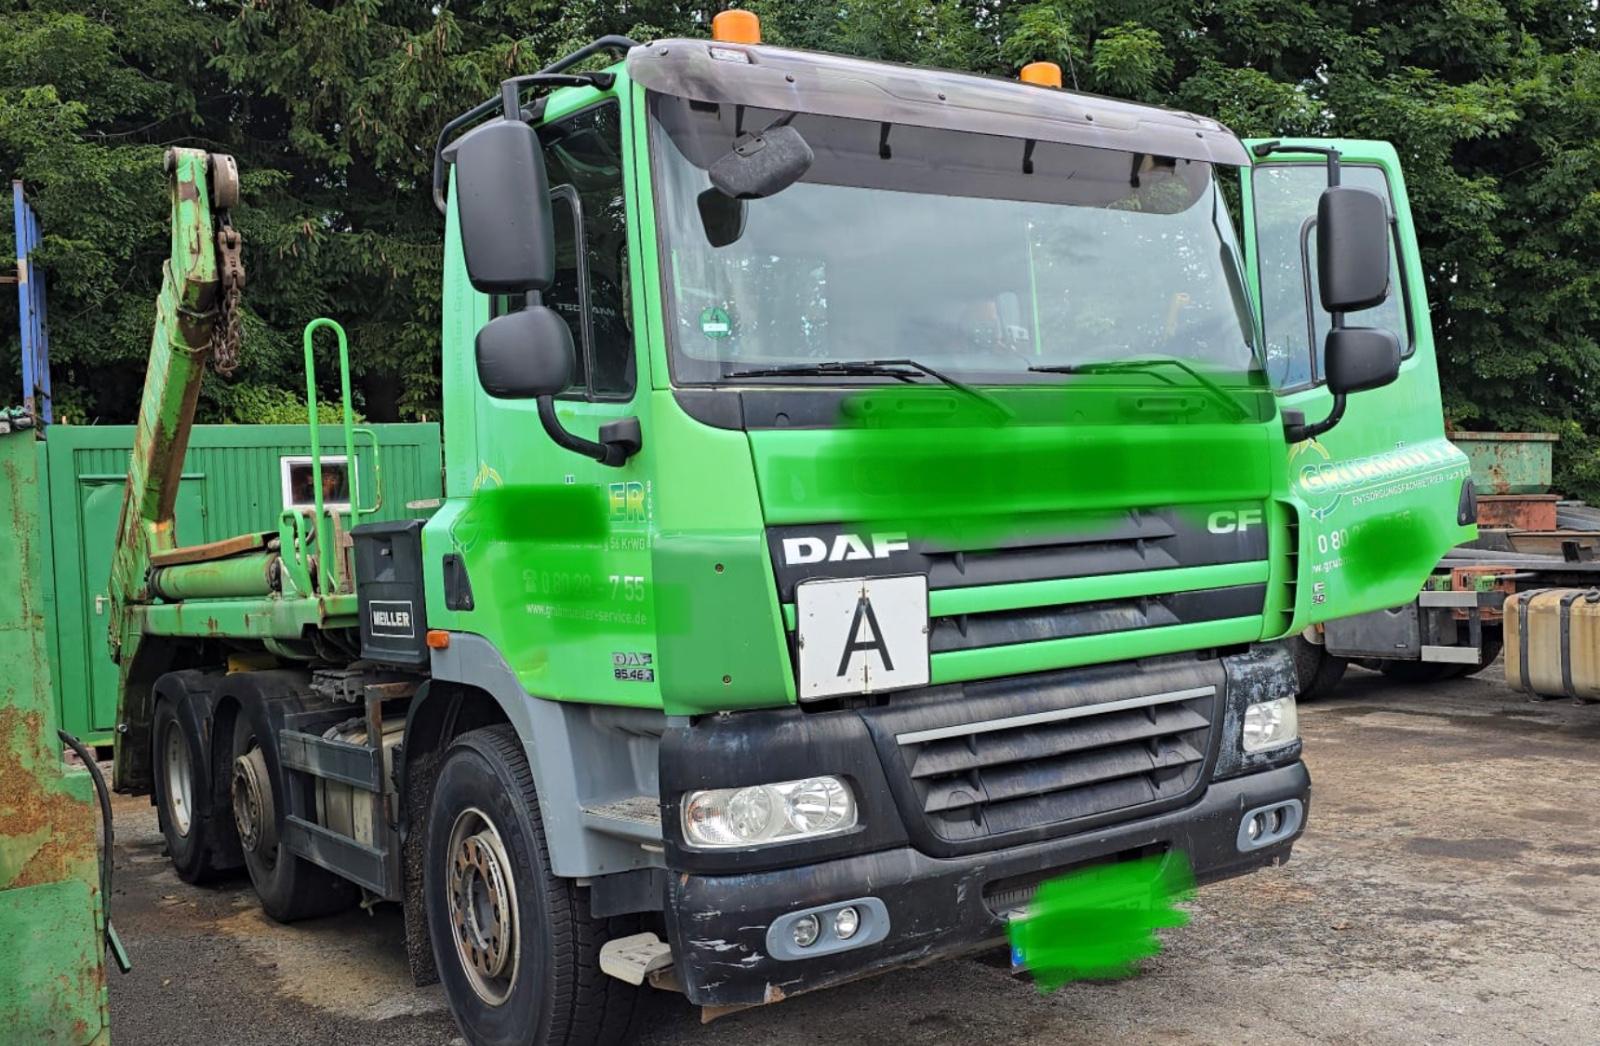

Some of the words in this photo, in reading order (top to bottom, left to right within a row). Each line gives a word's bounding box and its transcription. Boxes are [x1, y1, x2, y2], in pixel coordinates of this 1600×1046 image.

[710, 308, 720, 323] 4
[1207, 509, 1262, 534] CF
[783, 531, 909, 565] DAF
[608, 575, 620, 601] 7
[624, 576, 645, 602] 55
[373, 610, 411, 627] MEILLER
[836, 597, 895, 677] A
[612, 651, 652, 666] DAF
